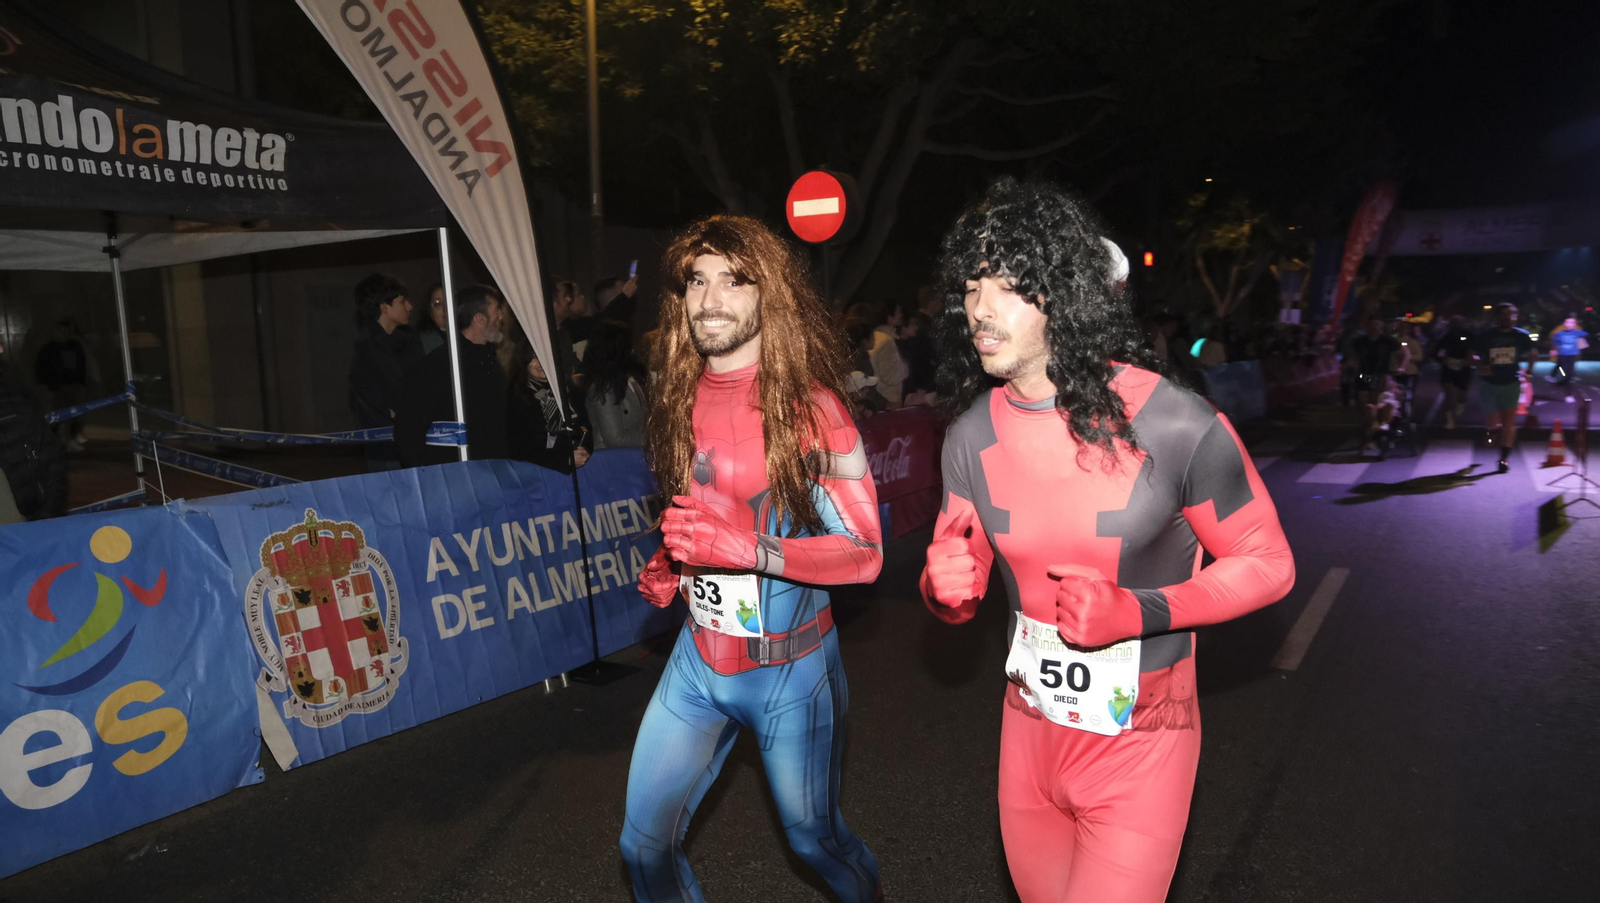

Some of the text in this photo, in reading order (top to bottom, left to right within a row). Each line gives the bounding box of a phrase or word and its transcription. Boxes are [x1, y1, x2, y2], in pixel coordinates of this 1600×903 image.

[181, 167, 288, 191] deportivo
[251, 578, 265, 600] LEAL
[431, 540, 646, 640] DE ALMERÍA
[693, 576, 722, 605] 53
[250, 602, 259, 622] MUY
[389, 604, 397, 644] LIBERTAD
[254, 626, 269, 654] NOBLE
[1040, 658, 1091, 692] 50
[312, 707, 344, 723] CIUDAD
[344, 702, 355, 711] DE
[1054, 694, 1078, 705] DIEGO
